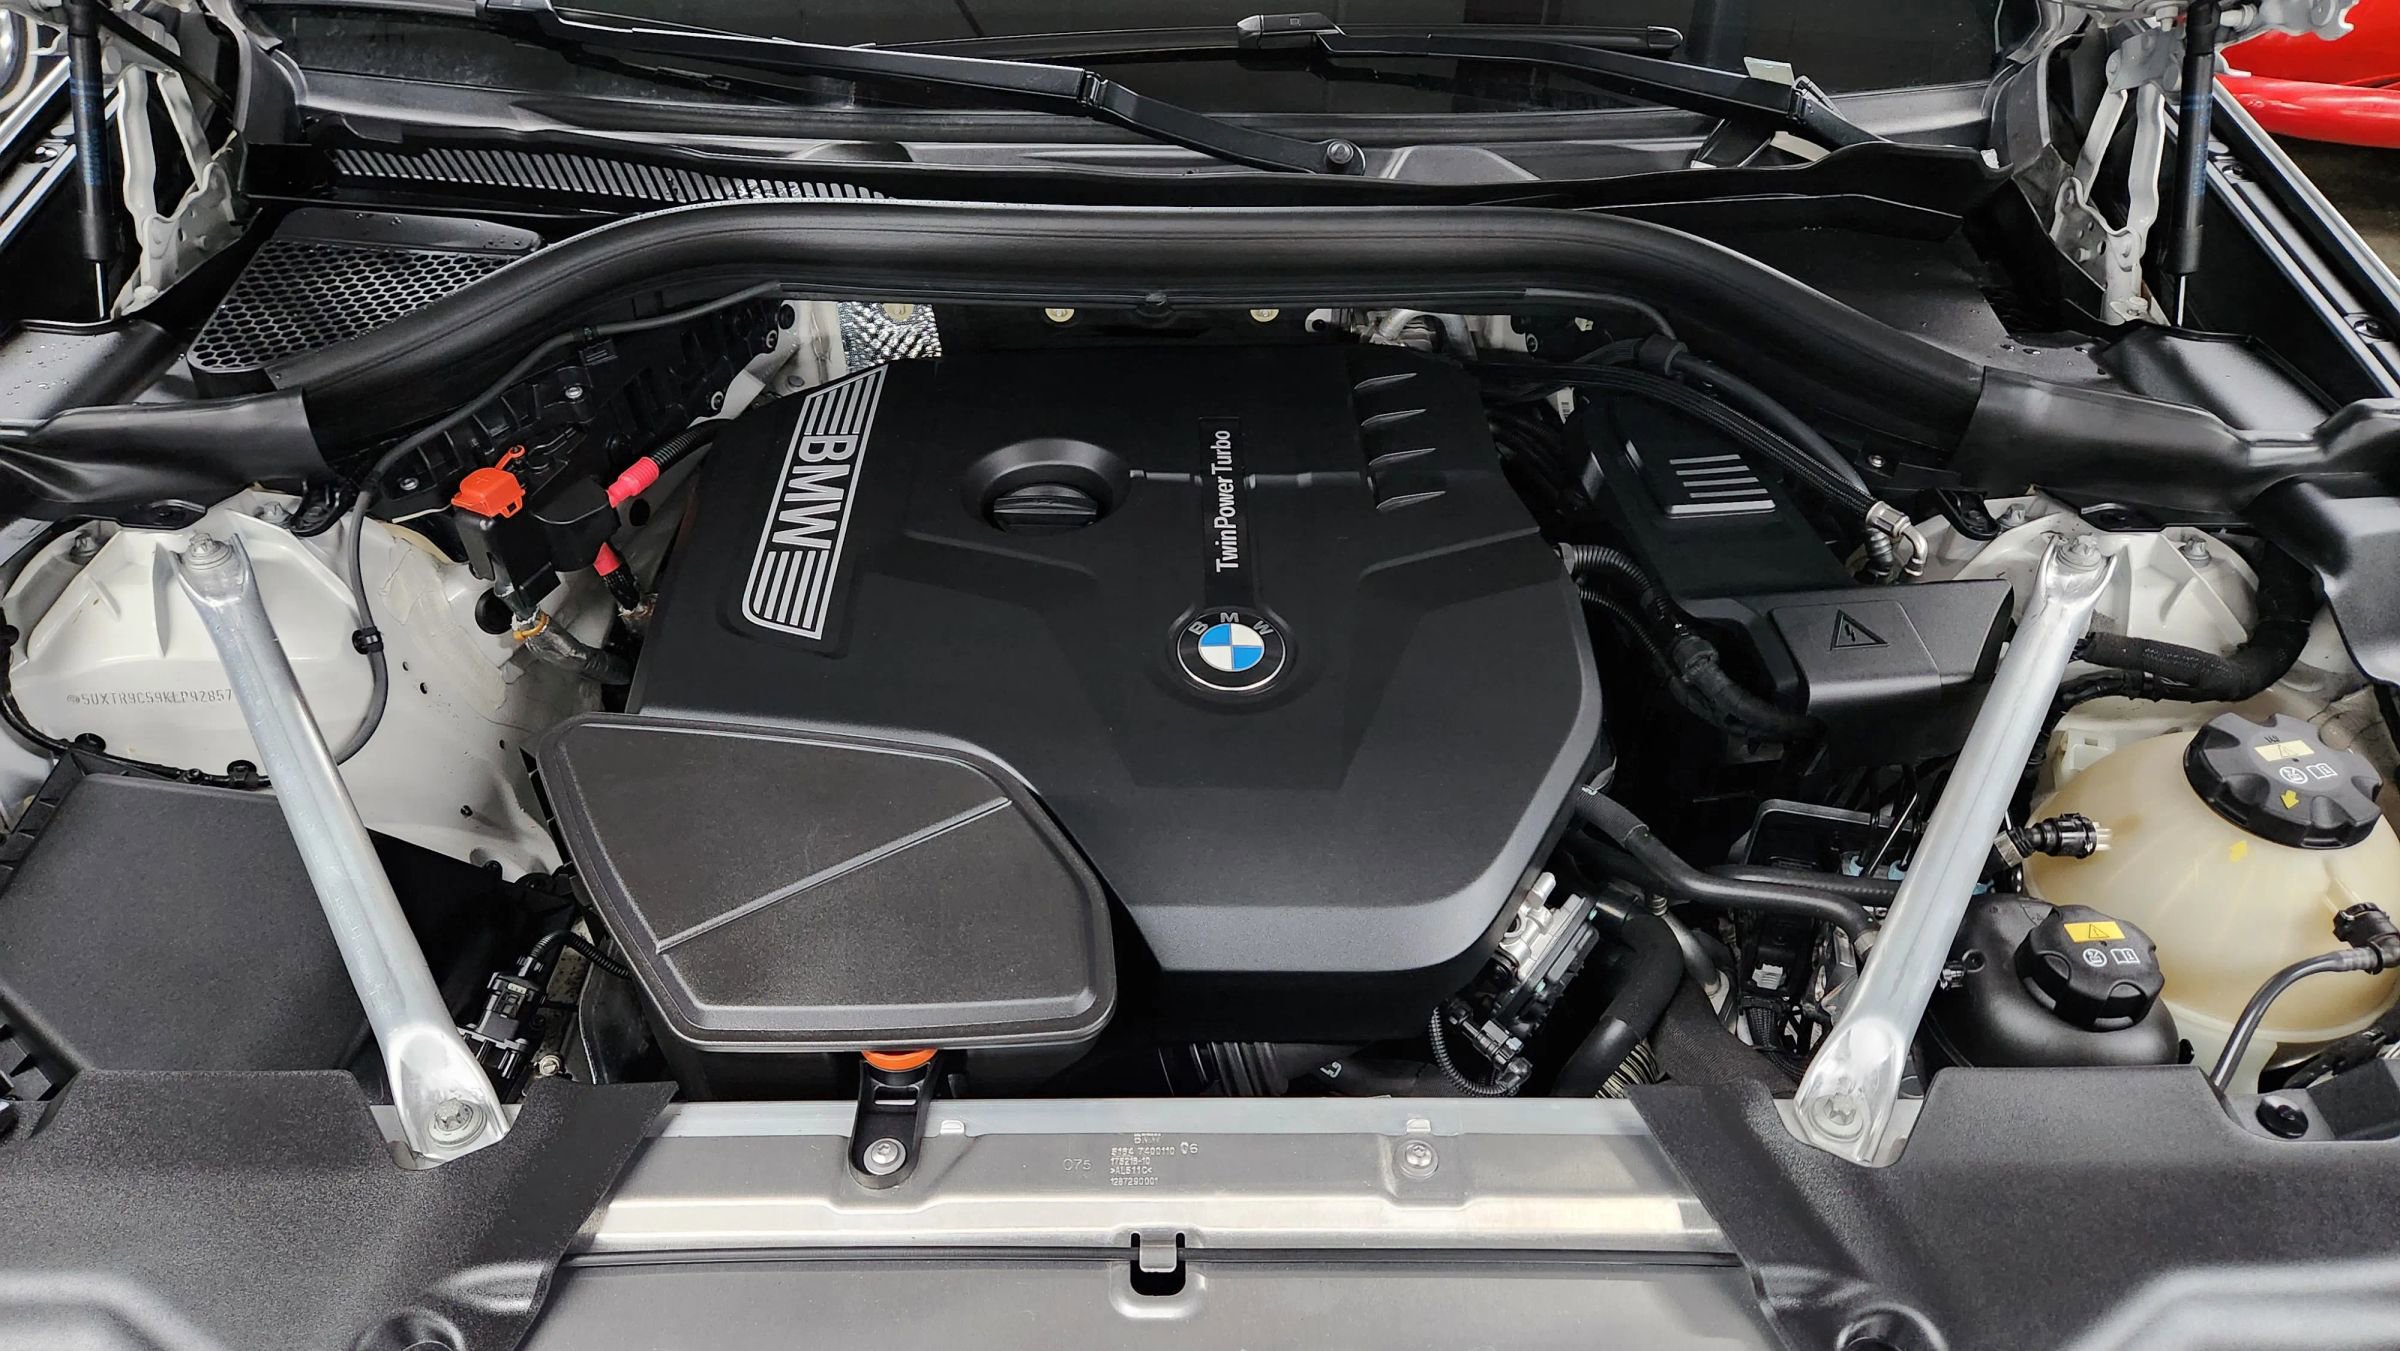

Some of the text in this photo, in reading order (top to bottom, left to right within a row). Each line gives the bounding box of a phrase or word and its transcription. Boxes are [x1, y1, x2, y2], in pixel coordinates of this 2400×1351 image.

[772, 435, 859, 549] BMW
[1210, 430, 1239, 573] TwinPower Turbo
[1188, 611, 1274, 637] BMW
